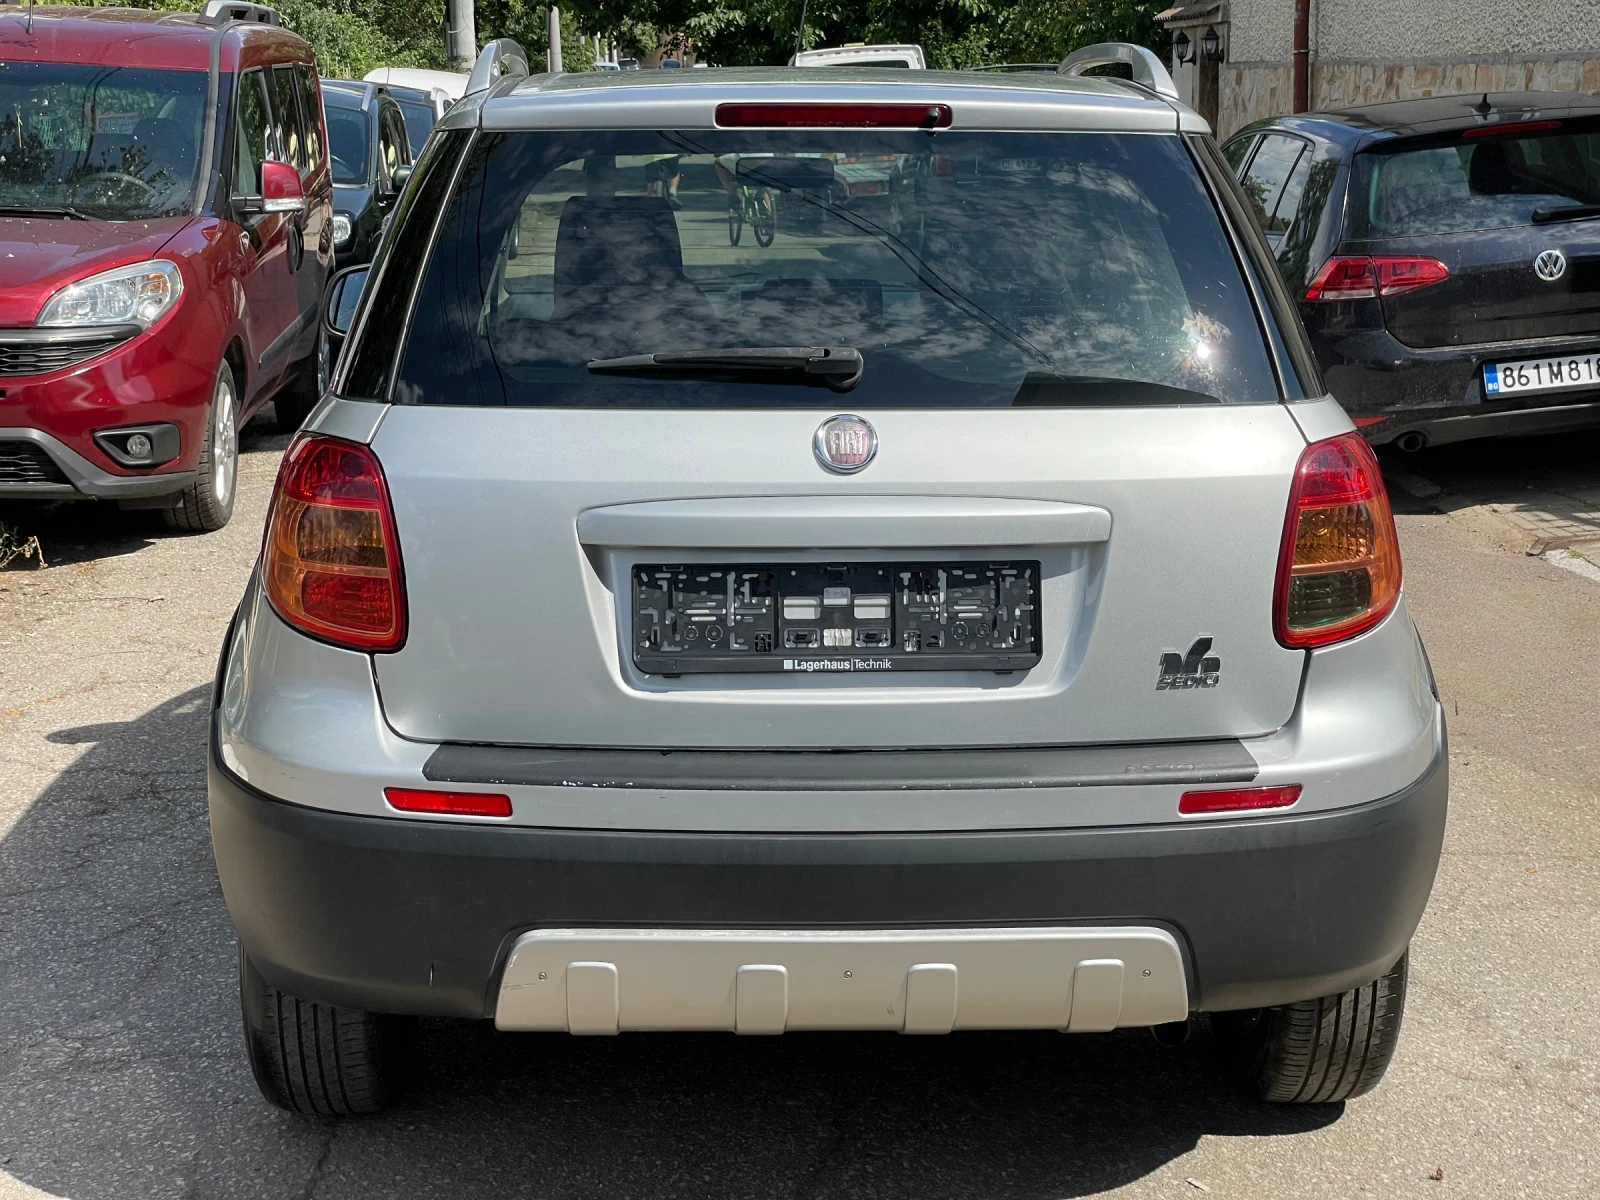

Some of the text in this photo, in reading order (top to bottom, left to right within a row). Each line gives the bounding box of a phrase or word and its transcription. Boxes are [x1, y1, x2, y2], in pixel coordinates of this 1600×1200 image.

[1488, 382, 1499, 390] BG
[829, 429, 866, 455] FIAT
[794, 658, 892, 672] Lagerhaus Technik
